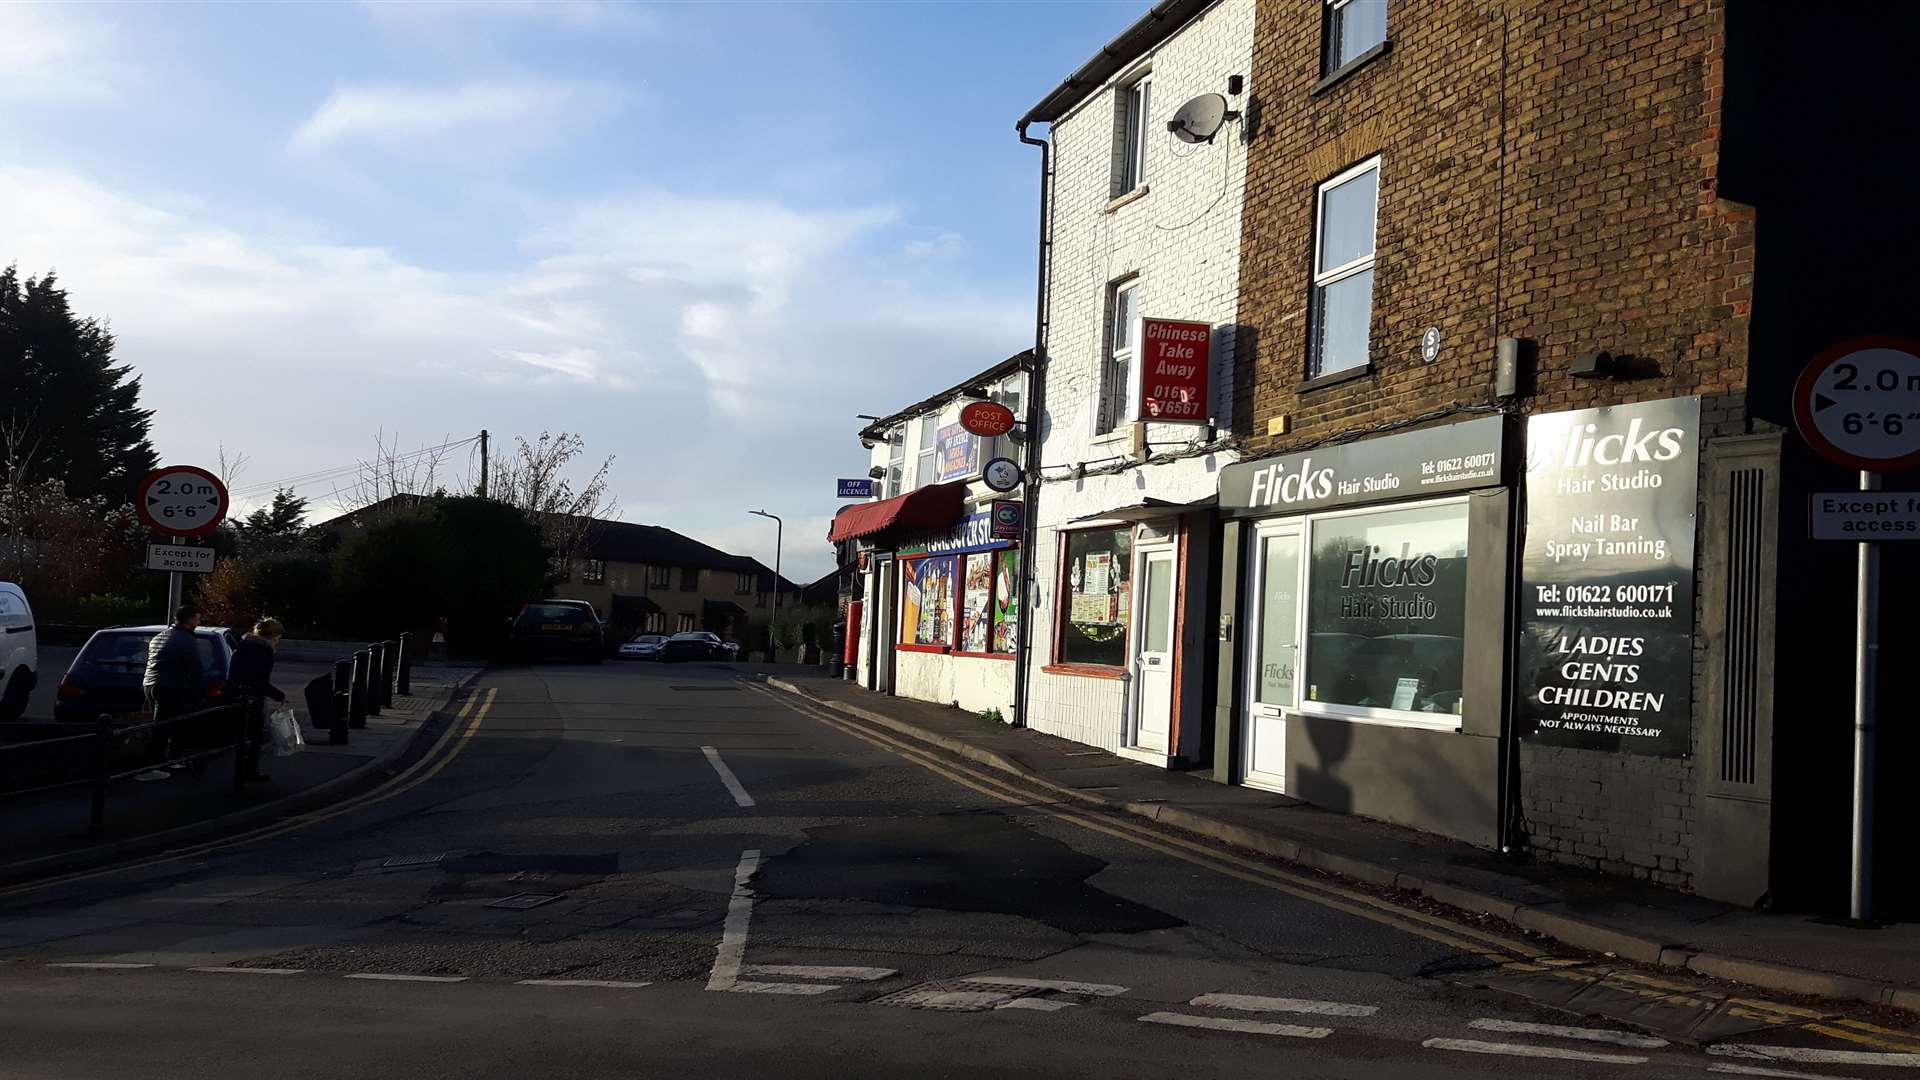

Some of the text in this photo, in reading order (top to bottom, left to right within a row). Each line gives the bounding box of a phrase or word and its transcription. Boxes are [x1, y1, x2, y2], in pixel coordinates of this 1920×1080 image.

[1146, 323, 1207, 342] Chinese
[1159, 342, 1194, 359] Take
[1155, 360, 1196, 380] Away
[1154, 385, 1197, 401] 0162
[975, 410, 1002, 421] POST
[1150, 400, 1200, 416] 76567
[969, 420, 1005, 431] OFFICE
[1552, 418, 1686, 468] licks
[1421, 452, 1495, 475] Tel: 01622 600171
[1249, 458, 1335, 508] Flicks
[1337, 473, 1400, 496] Hair Studio
[1557, 469, 1663, 494] Hair Studio
[1822, 498, 1899, 515] Except
[1571, 514, 1639, 534] Nail Bar
[1842, 519, 1917, 532] access
[155, 547, 210, 559] Except for
[1545, 536, 1666, 562] Spray Tanning
[163, 559, 200, 568] access
[1340, 542, 1438, 589] Flicks
[1536, 584, 1673, 603] Tel: 01622 600171
[1340, 592, 1438, 620] Hair Studio
[1536, 605, 1672, 618] www.flickshairstudio.co.uk
[1559, 636, 1644, 656] LADIES
[1264, 663, 1294, 681] Flicks
[1561, 662, 1640, 683] GENTS
[1538, 686, 1664, 712] CHILDREN
[1539, 719, 1662, 738] NOT ALWAYS NECESSARY
[1560, 712, 1639, 726] APPOINTMENTS
